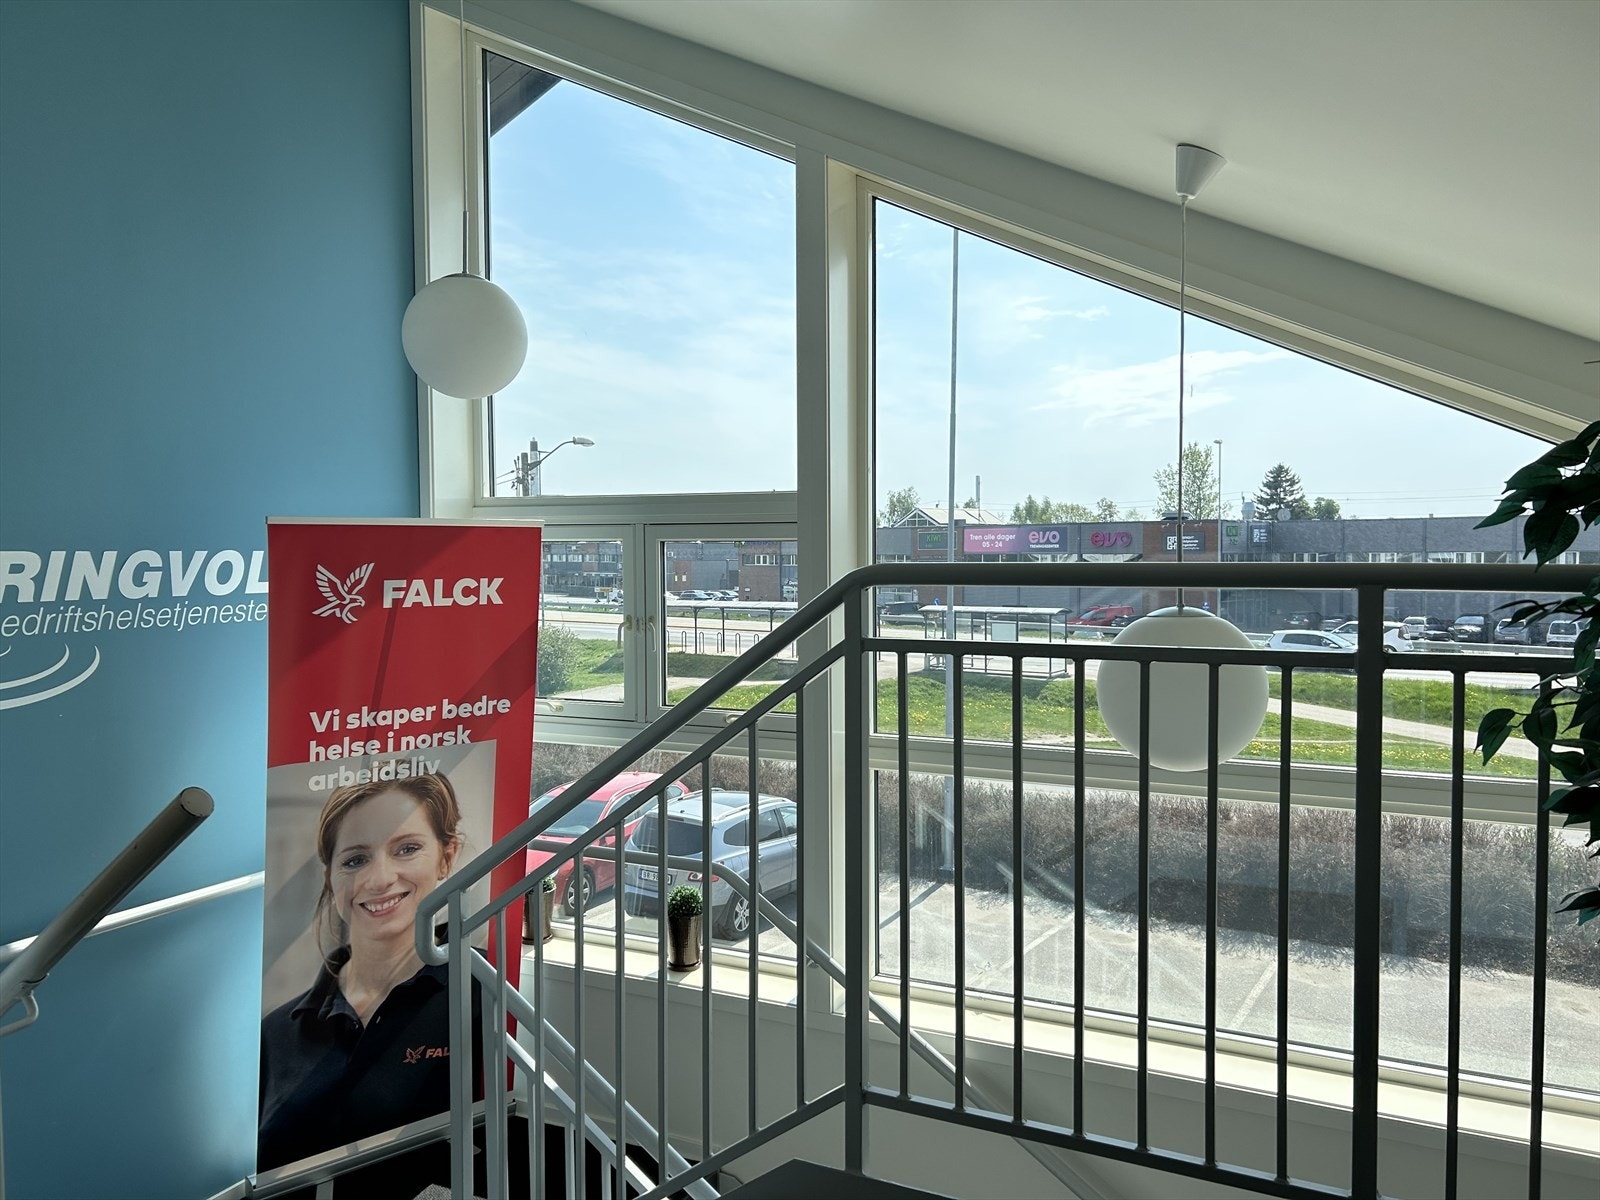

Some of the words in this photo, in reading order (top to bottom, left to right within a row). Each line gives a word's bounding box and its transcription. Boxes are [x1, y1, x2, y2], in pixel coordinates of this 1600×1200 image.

[969, 533, 983, 541] Tren
[983, 533, 996, 541] alle
[996, 533, 1016, 541] dager
[1028, 530, 1060, 544] evo
[1090, 531, 1132, 548] evo
[382, 577, 504, 609] FALCK
[309, 708, 341, 733] Vi
[345, 705, 437, 730] skaper
[441, 694, 511, 720] bedre
[309, 736, 381, 763] helse
[387, 731, 394, 753] i
[400, 724, 473, 752] norsk
[308, 755, 441, 791] arbeidsliv
[425, 1046, 450, 1059] FAL
